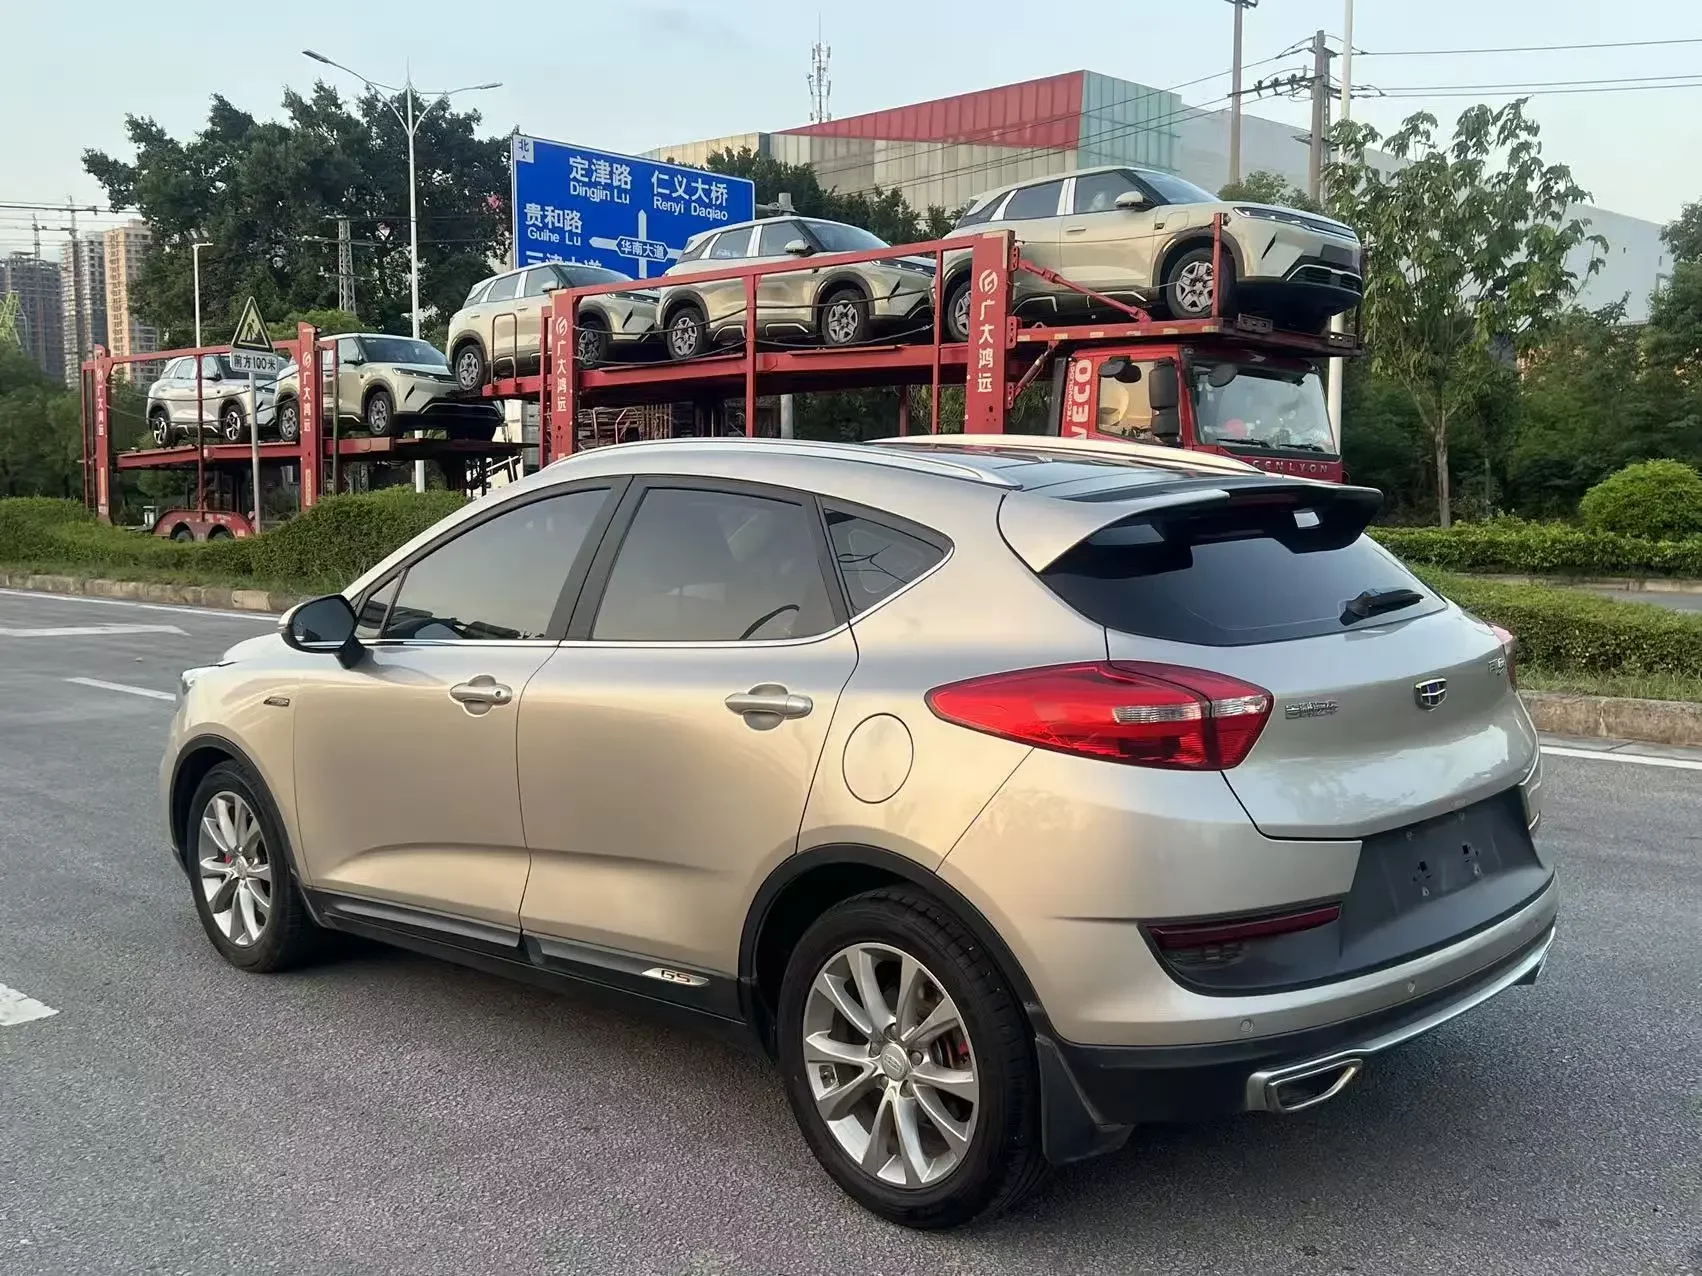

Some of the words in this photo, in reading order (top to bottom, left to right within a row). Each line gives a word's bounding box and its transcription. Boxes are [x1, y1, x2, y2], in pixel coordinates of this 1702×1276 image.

[518, 138, 530, 153] 北
[569, 155, 632, 190] 定津路
[570, 181, 611, 202] Dingjin
[614, 189, 630, 204] Lu
[651, 169, 728, 207] 仁义大桥
[524, 203, 582, 233] 贵和路
[653, 196, 684, 216] Renyi
[691, 202, 728, 221] Daqiao
[527, 227, 560, 243] Guihe
[565, 232, 581, 246] Lu
[621, 240, 665, 259] 华南大道
[977, 299, 996, 393] 广大鸿远
[233, 354, 276, 370] 前方100米
[1066, 361, 1077, 422] TECHNOLOGY
